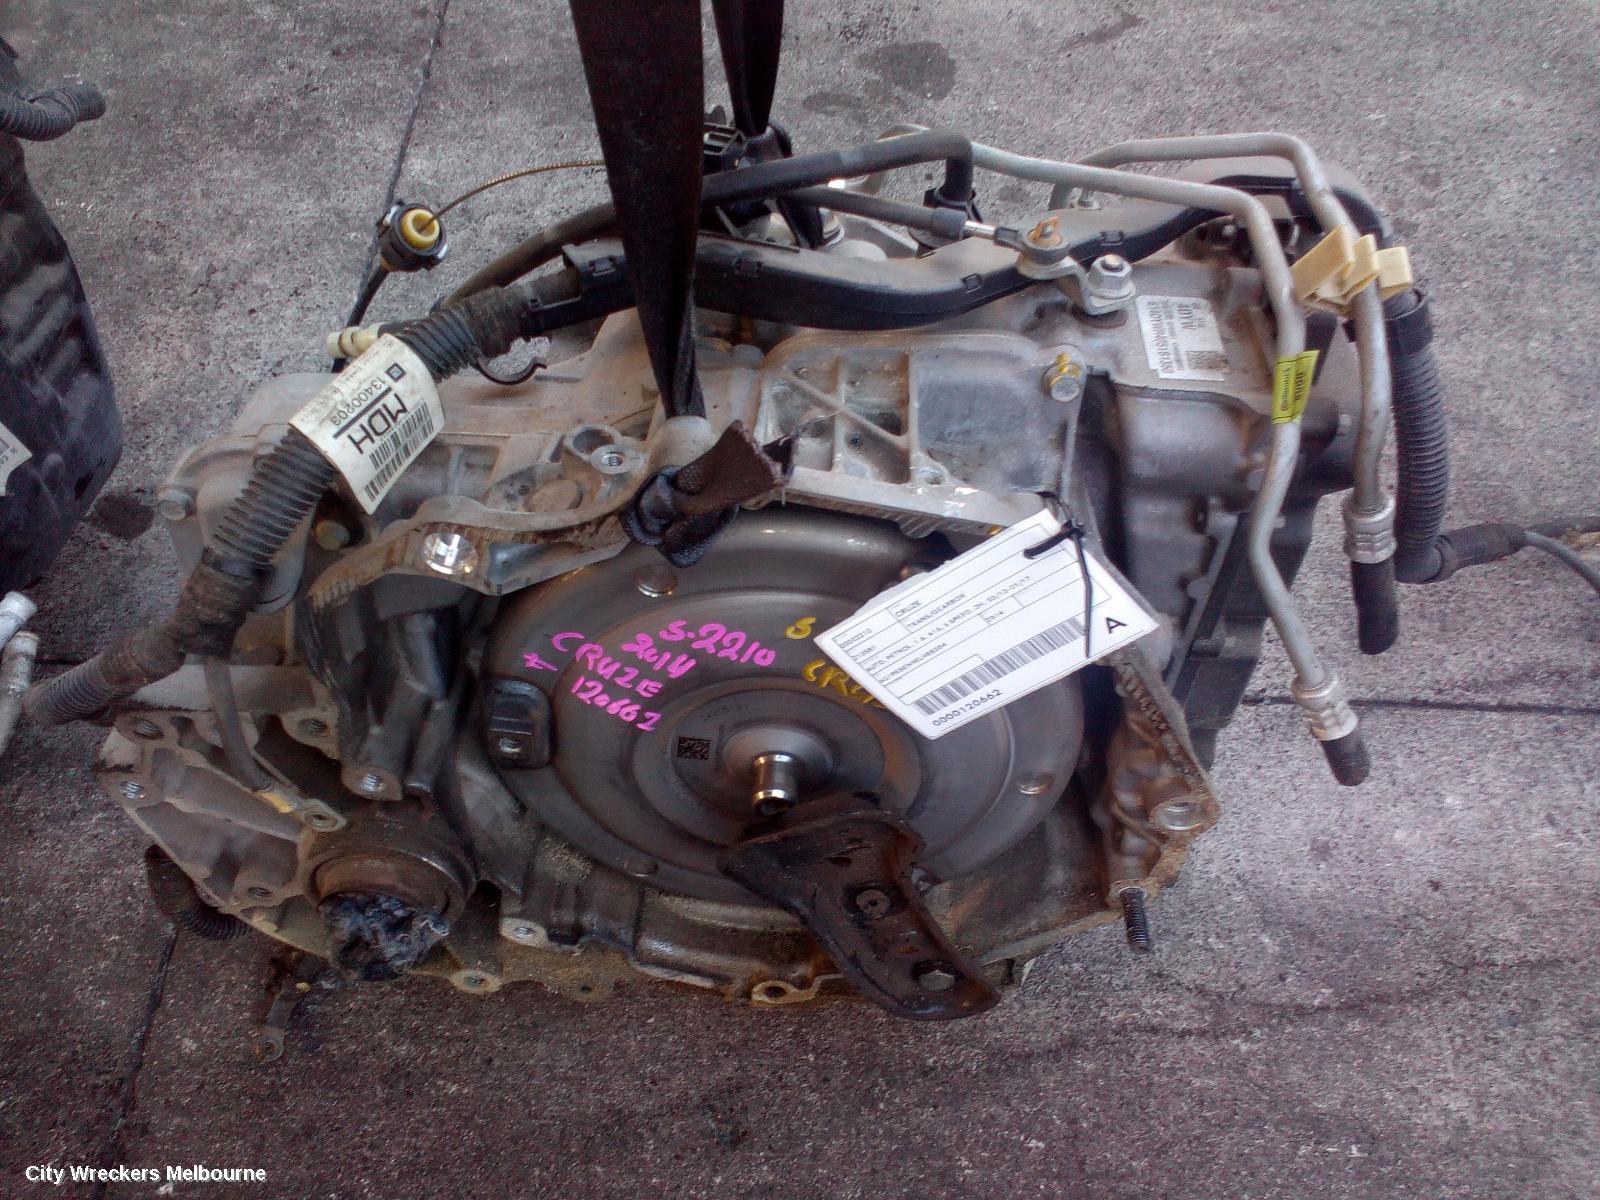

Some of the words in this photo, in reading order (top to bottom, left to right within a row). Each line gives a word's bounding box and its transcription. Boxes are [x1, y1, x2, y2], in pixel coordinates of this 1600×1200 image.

[347, 393, 408, 455] MDH
[1105, 615, 1128, 635] A
[552, 631, 663, 698] CRUZE
[570, 675, 662, 732] 120662
[931, 688, 1002, 728] 0000120662
